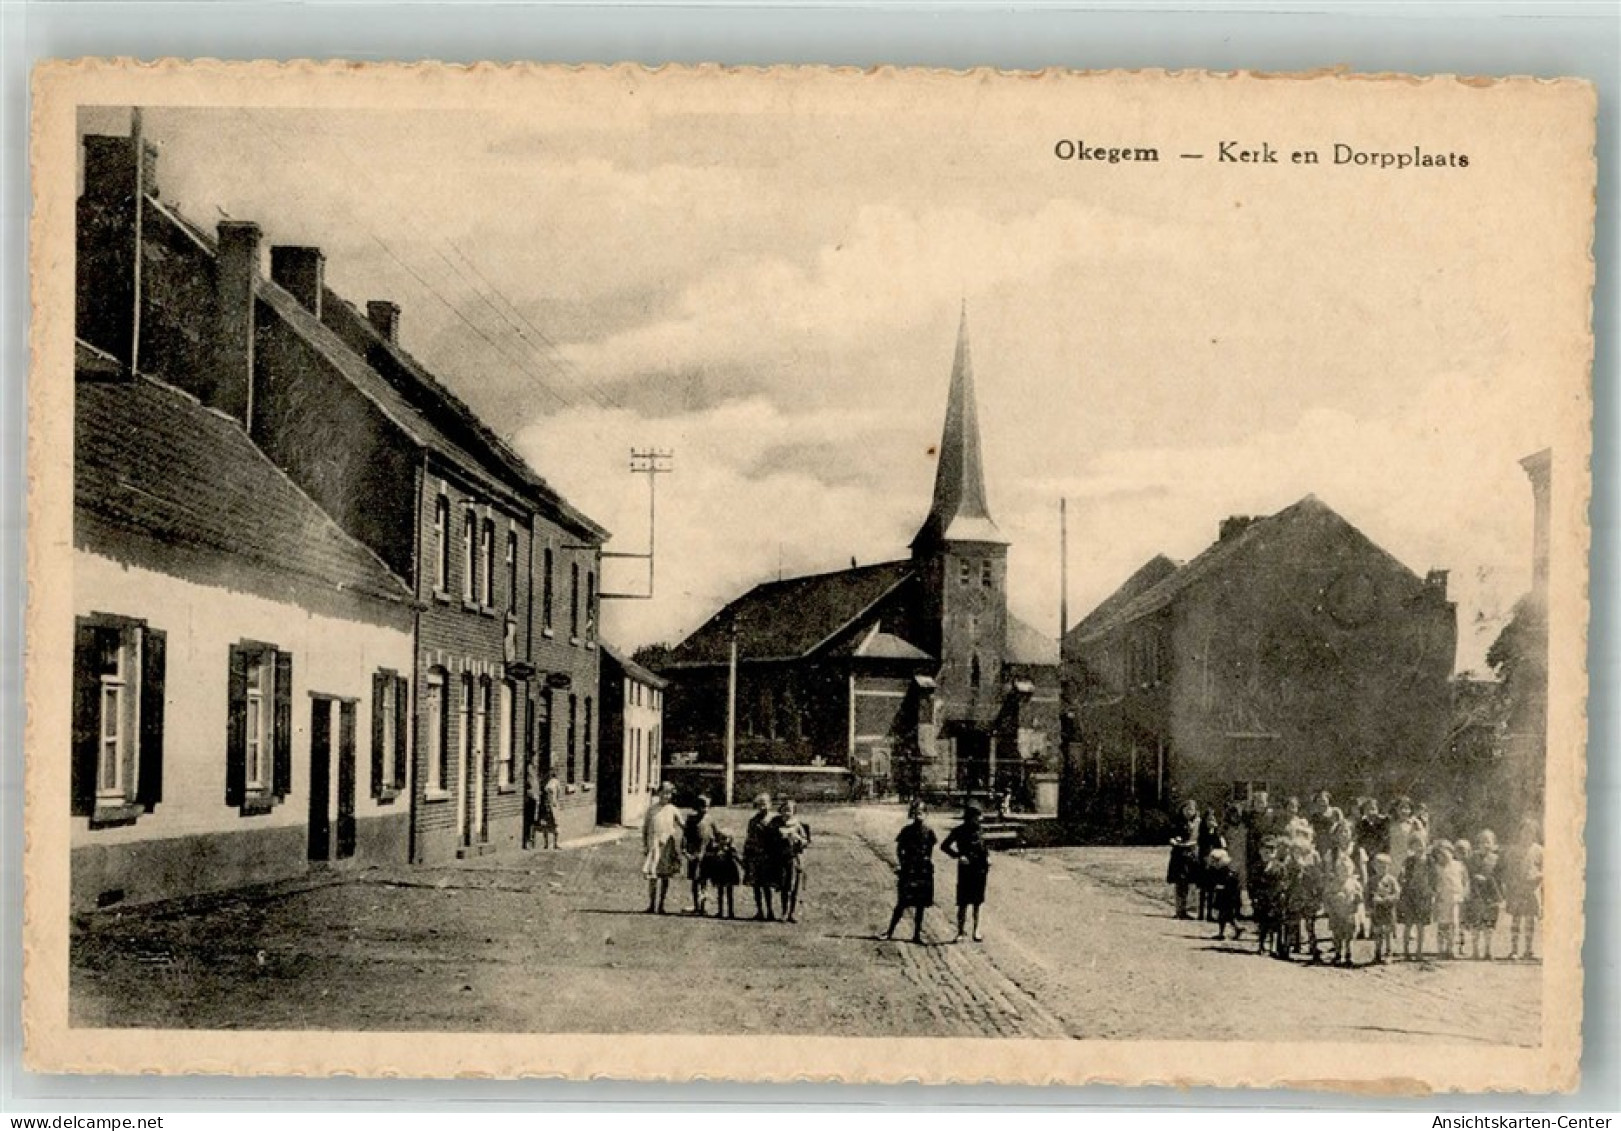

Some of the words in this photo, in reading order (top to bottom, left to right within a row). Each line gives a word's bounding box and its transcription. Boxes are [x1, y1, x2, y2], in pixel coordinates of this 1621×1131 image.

[1055, 140, 1159, 164] Okegem
[1218, 141, 1278, 163] Kerk
[1291, 151, 1318, 164] en
[1333, 143, 1469, 169] Dorpplaats
